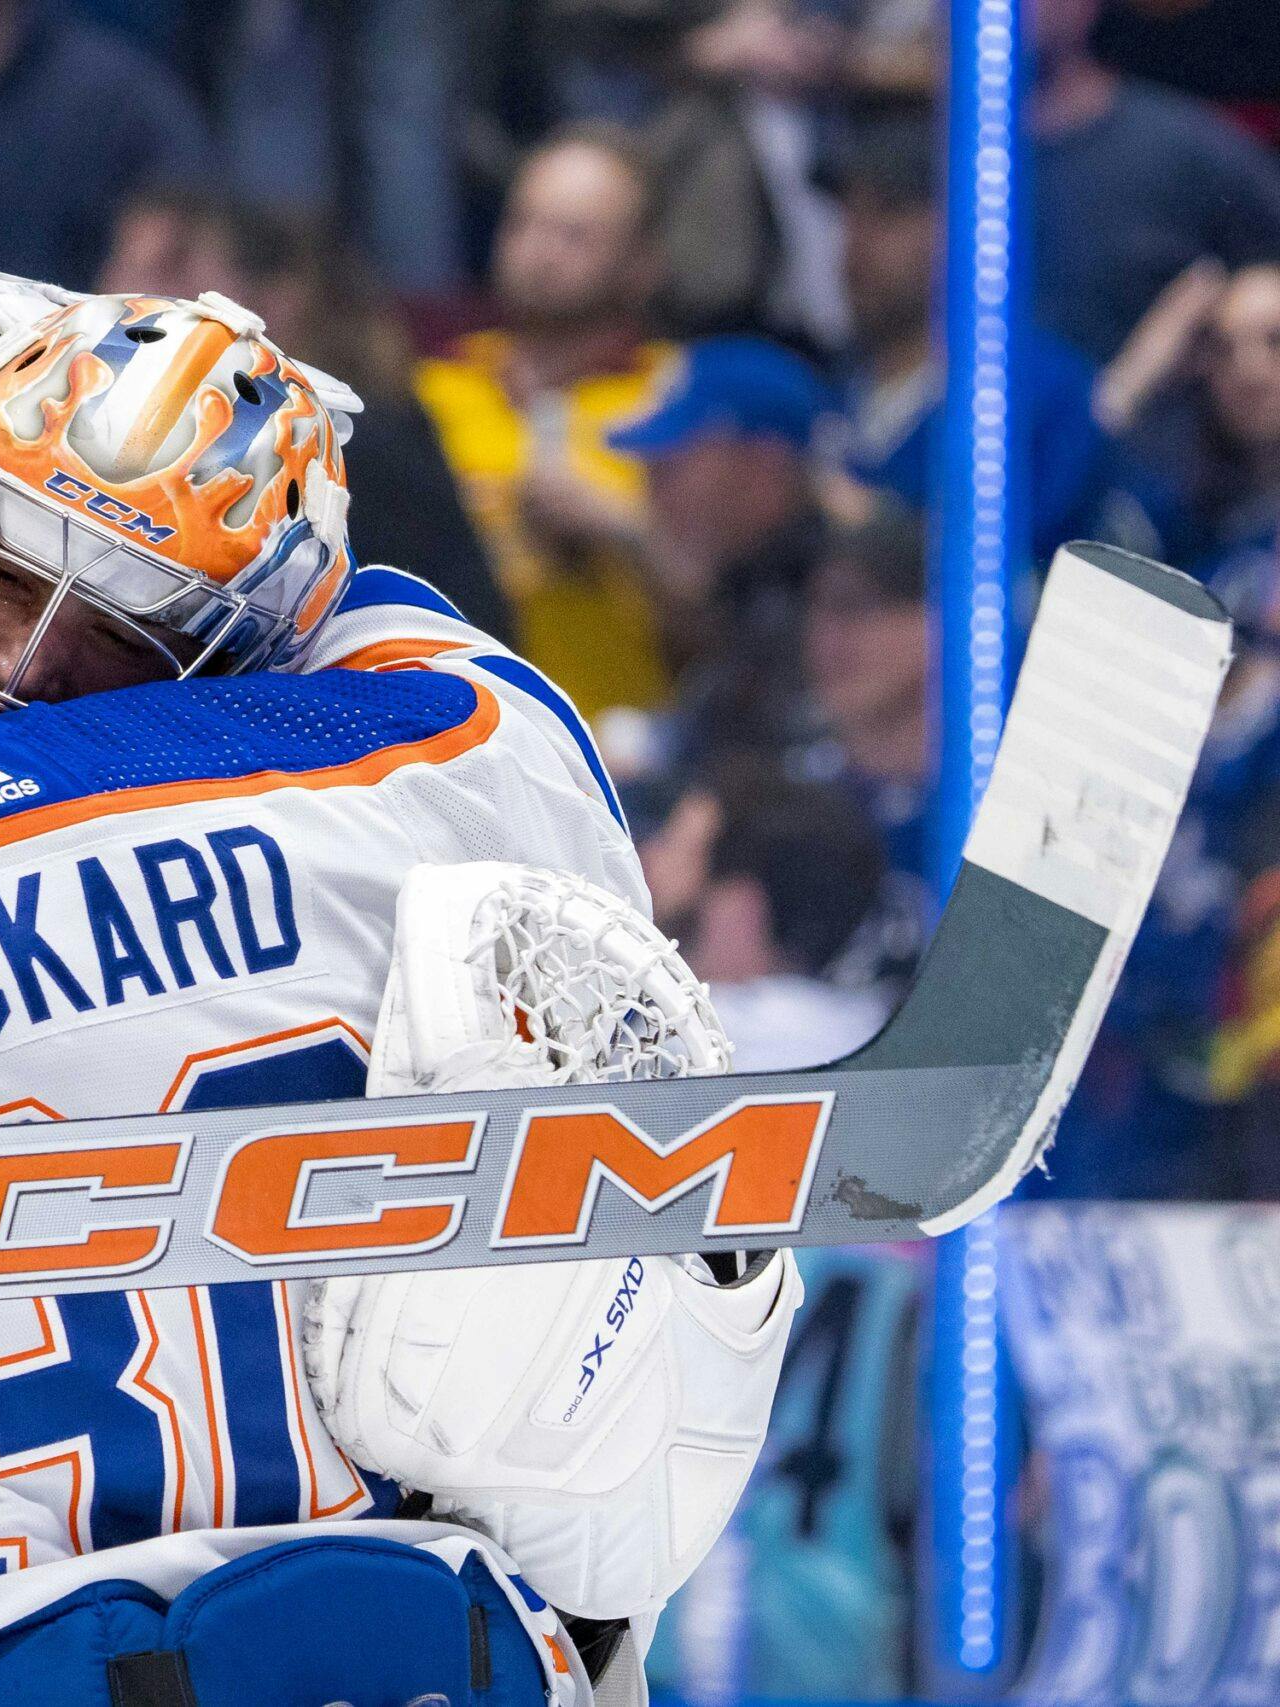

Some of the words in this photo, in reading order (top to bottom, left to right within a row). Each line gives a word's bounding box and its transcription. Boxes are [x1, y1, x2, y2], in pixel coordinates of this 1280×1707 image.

[43, 467, 177, 544] CCM
[580, 1333, 616, 1395] XF
[563, 1395, 583, 1423] PRO
